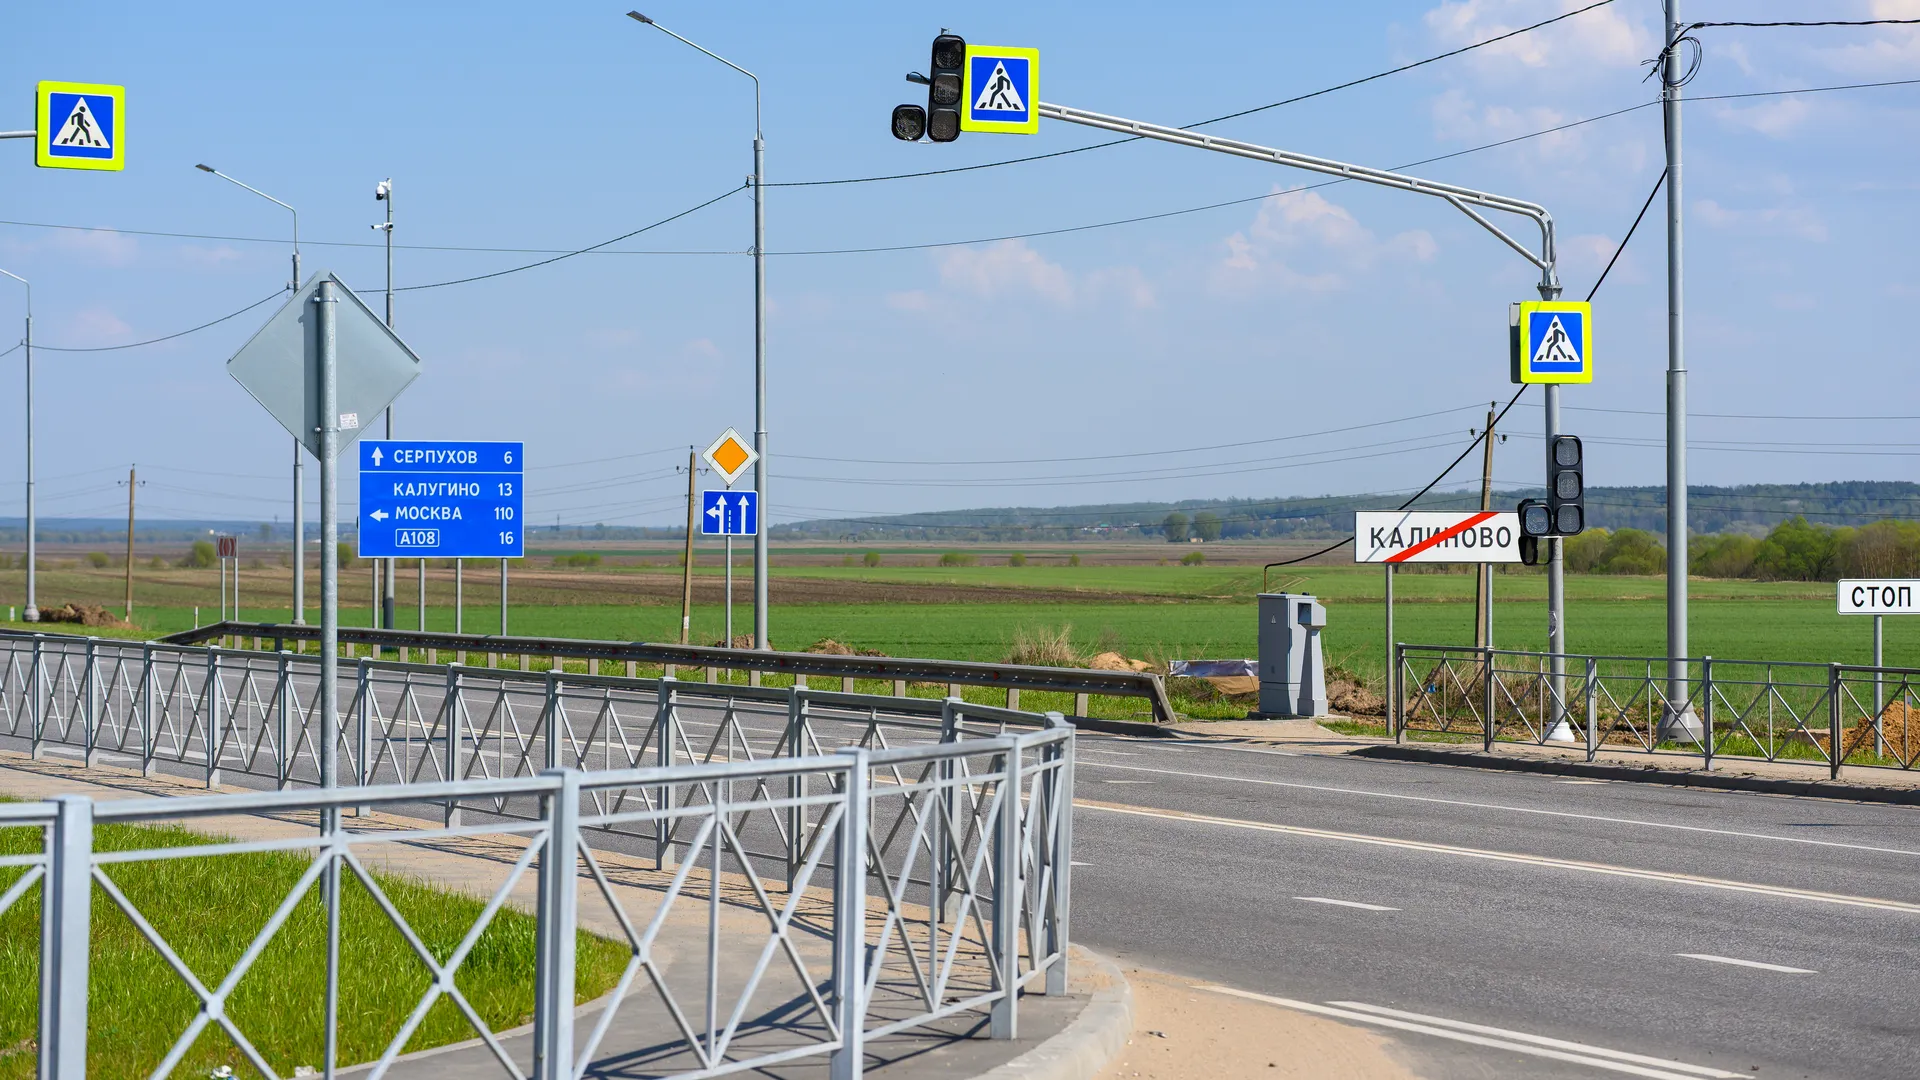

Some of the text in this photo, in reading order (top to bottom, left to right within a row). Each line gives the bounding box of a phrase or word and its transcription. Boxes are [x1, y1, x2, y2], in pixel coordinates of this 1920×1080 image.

[394, 450, 513, 465] СЕРПУХОВ 6
[393, 483, 513, 496] КАЛУГИНО 13
[395, 506, 514, 520] МОСКВА 110
[499, 531, 514, 545] 16
[1852, 586, 1911, 607] СТОП
